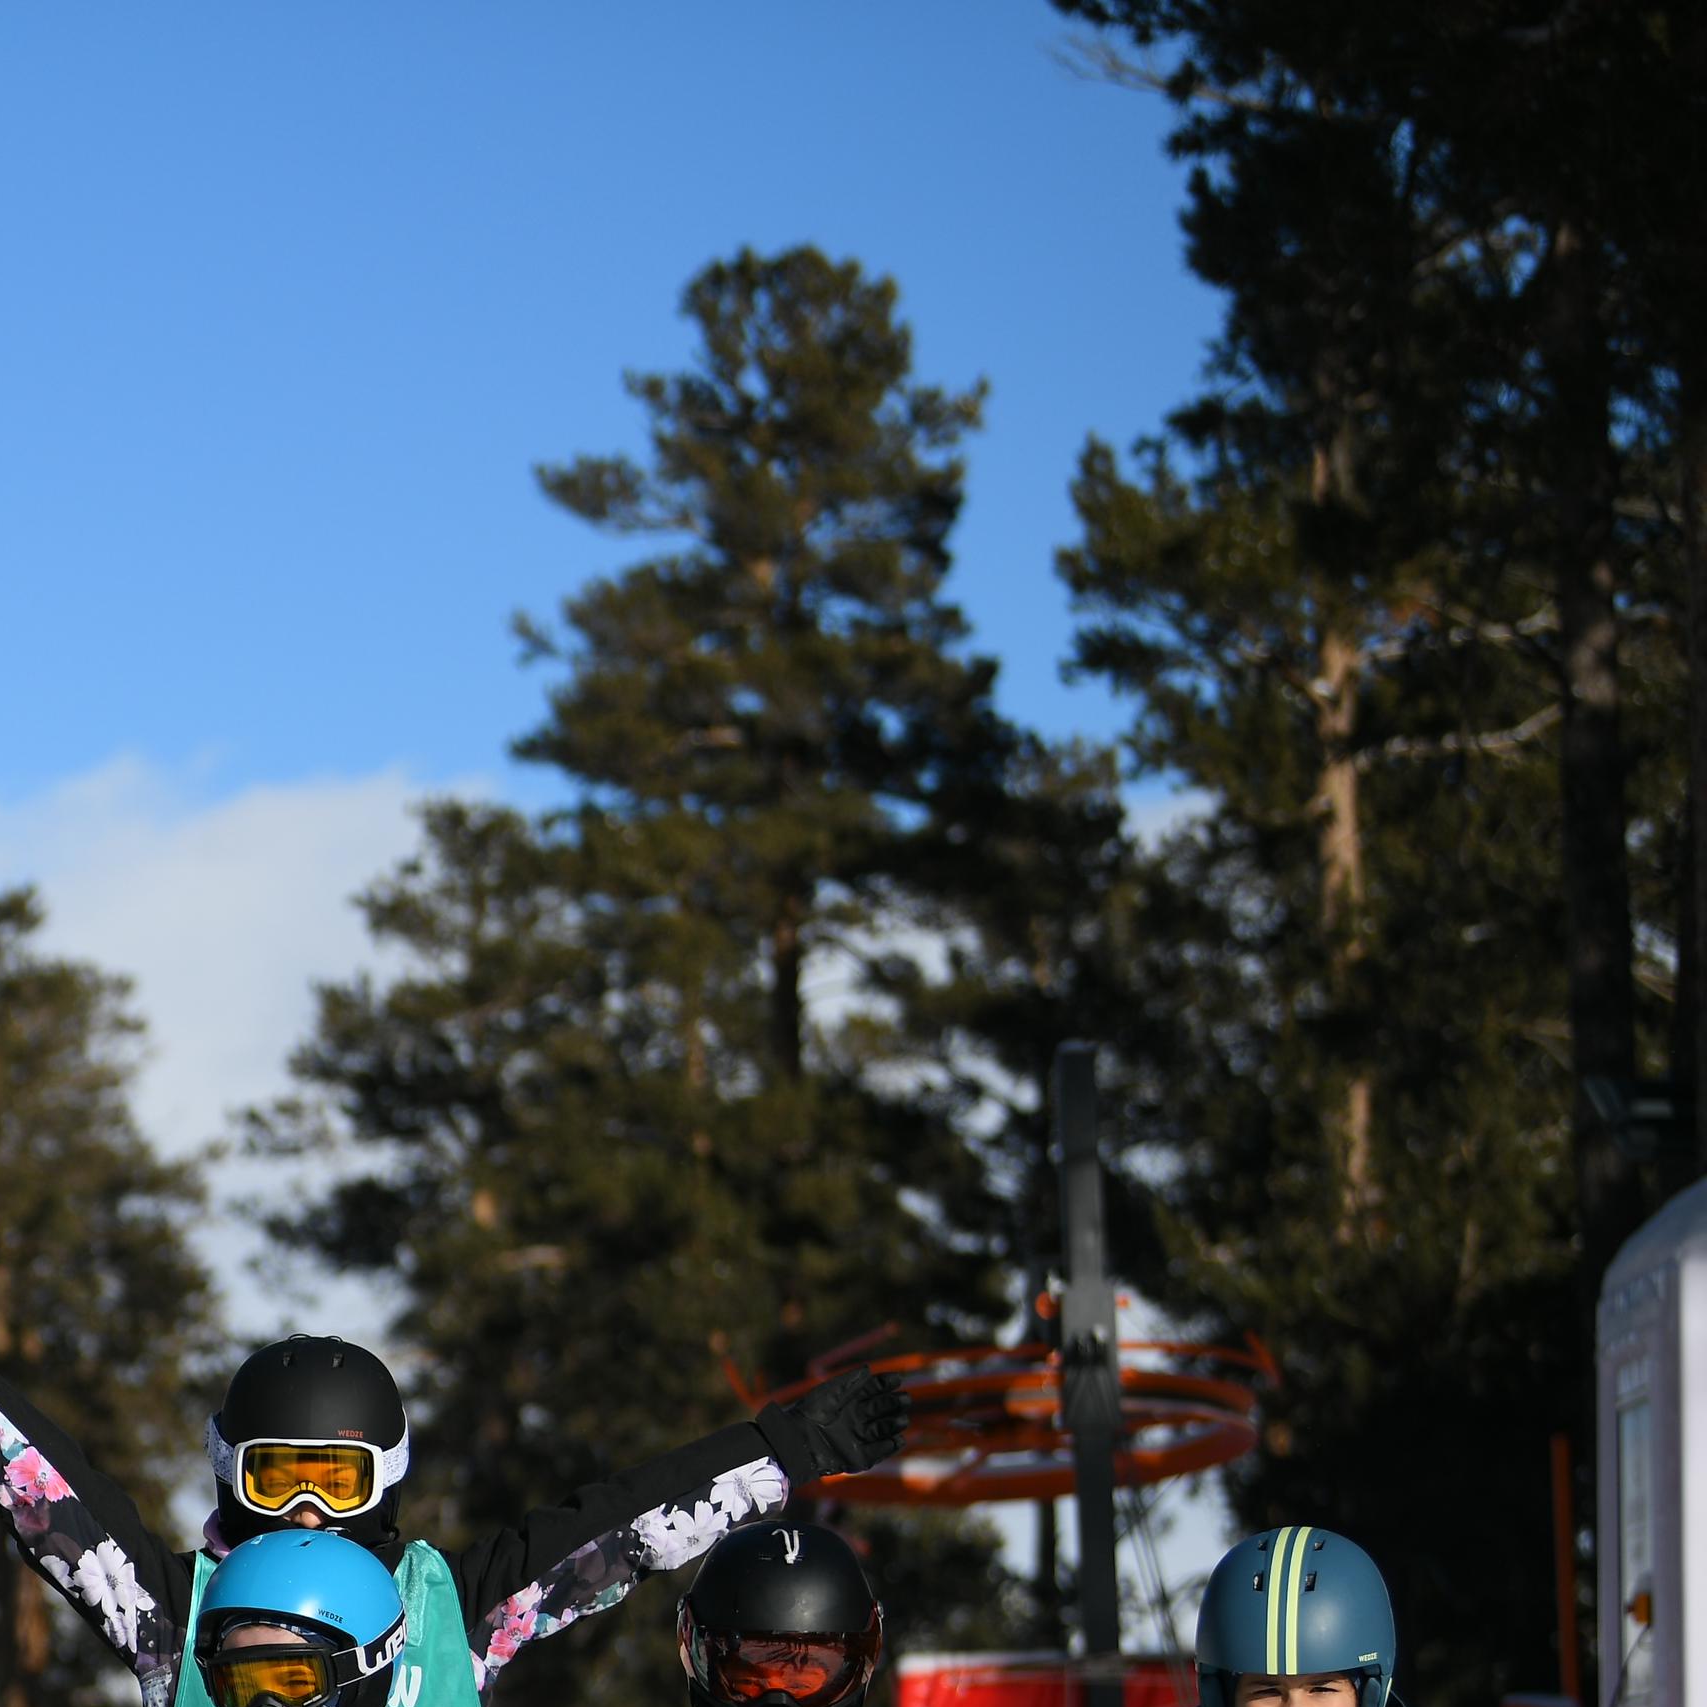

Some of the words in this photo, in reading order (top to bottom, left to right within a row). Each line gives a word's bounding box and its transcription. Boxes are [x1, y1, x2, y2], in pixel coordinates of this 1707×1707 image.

[338, 1430, 364, 1439] WEDZE
[318, 1608, 344, 1624] WEDZE
[1358, 1652, 1378, 1663] WEDZE
